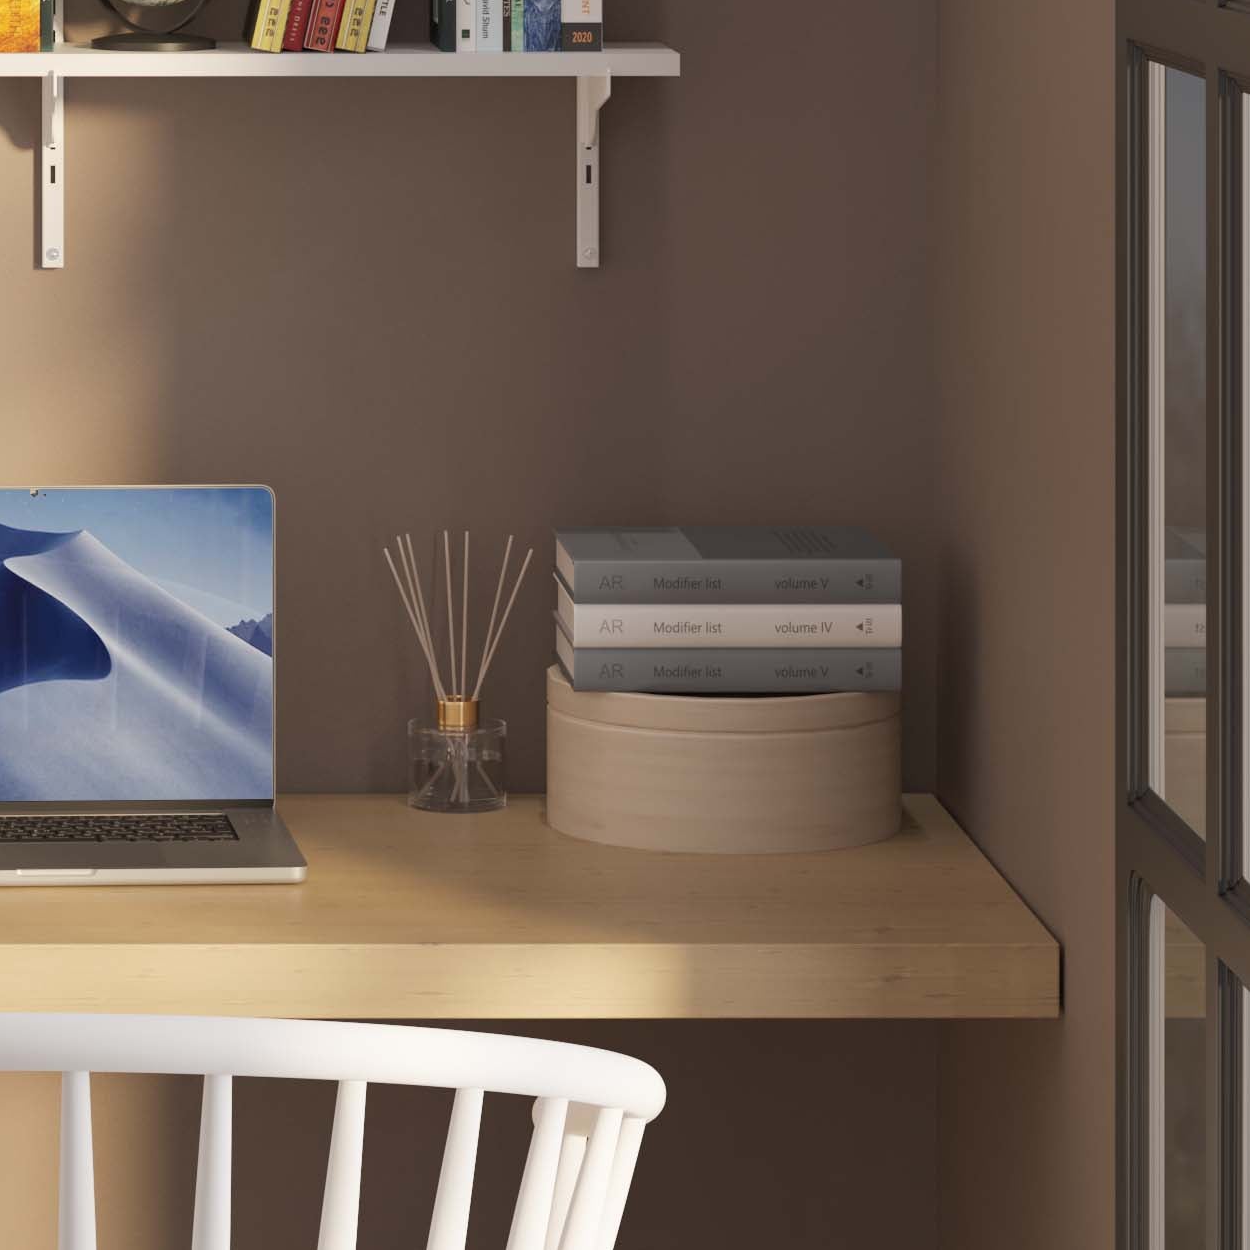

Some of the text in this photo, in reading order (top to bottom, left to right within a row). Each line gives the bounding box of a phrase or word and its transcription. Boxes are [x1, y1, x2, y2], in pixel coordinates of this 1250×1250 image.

[572, 30, 593, 44] 2020
[599, 576, 830, 590] AR Modifier list volume V
[599, 620, 833, 634] AR Modifier list volume IV
[599, 664, 830, 678] AR Modifier list volume V
